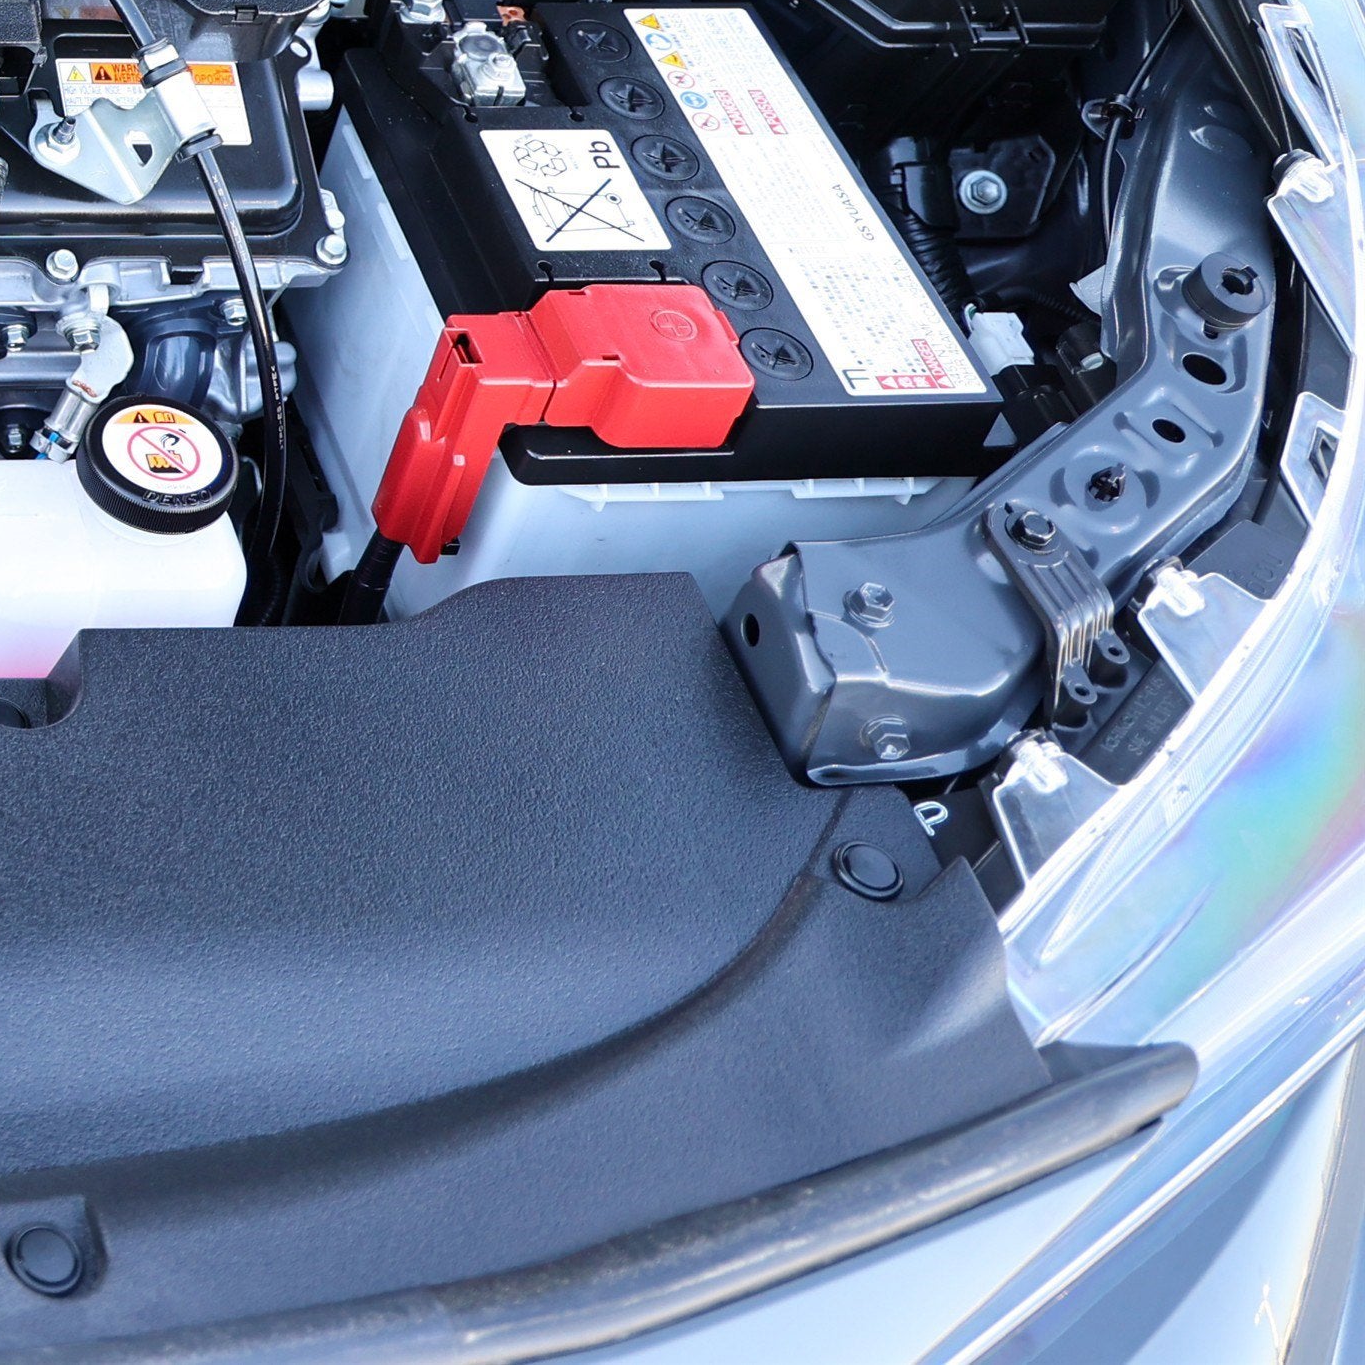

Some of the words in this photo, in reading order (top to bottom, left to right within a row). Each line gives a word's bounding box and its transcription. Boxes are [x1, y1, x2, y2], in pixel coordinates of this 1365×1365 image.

[714, 90, 746, 124] DANGER
[749, 91, 781, 124] POISON
[588, 141, 620, 169] Pb
[829, 184, 865, 222] YUASA
[854, 225, 876, 240] GS
[912, 340, 946, 375] DANGER
[141, 490, 212, 506] DENSO
